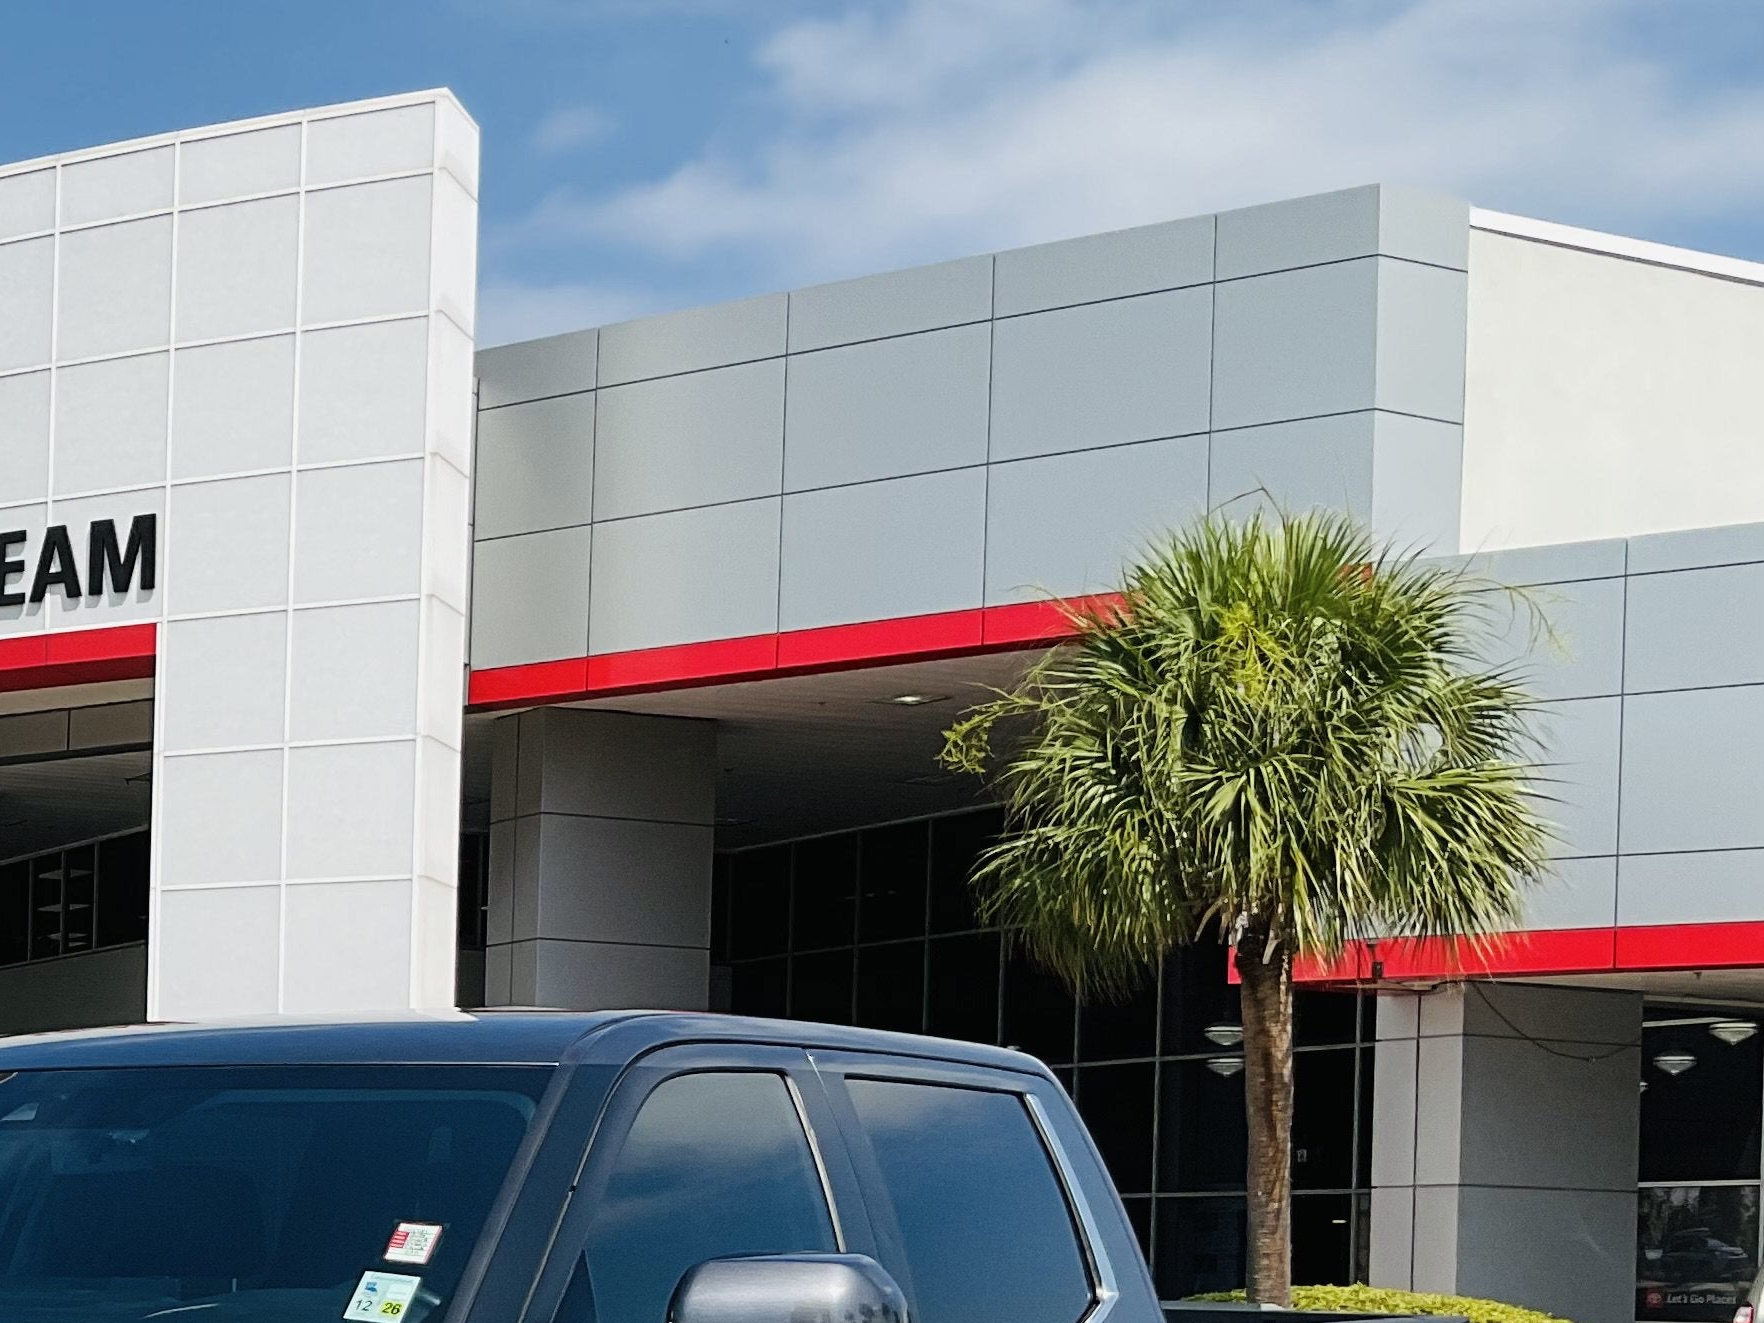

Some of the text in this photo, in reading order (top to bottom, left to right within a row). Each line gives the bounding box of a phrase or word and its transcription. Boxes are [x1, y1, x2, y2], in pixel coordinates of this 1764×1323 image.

[1690, 1294, 1705, 1304] Go
[356, 1300, 373, 1311] 12
[381, 1302, 402, 1315] 26
